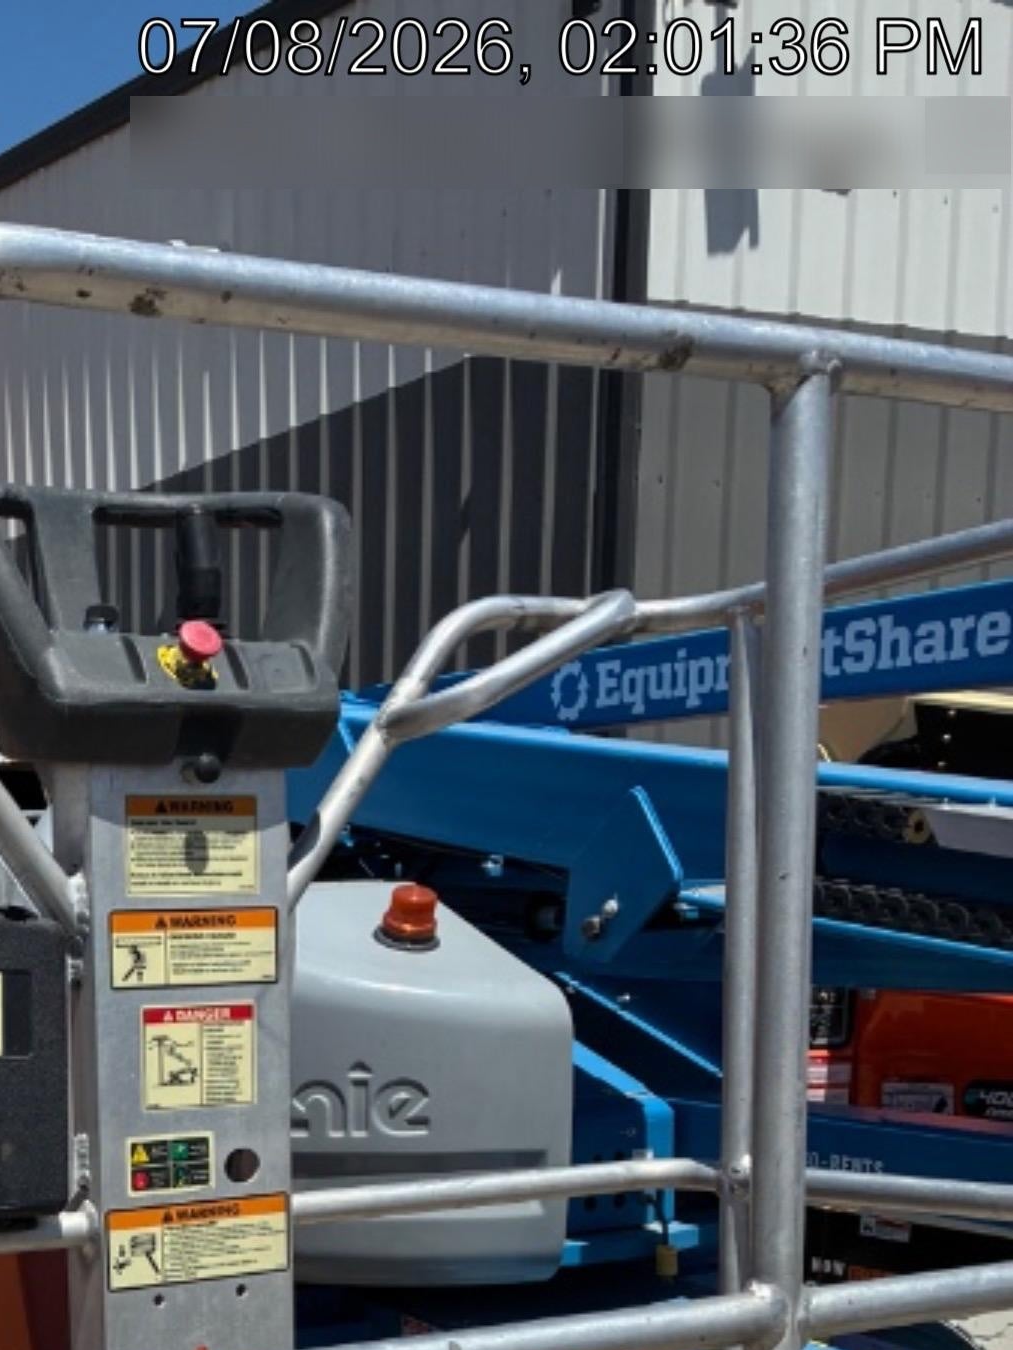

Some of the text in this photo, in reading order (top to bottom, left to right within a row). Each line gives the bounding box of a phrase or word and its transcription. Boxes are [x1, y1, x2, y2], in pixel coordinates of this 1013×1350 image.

[169, 914, 237, 928] WARNING
[175, 1008, 231, 1021] DANGER
[290, 1060, 431, 1138] nie
